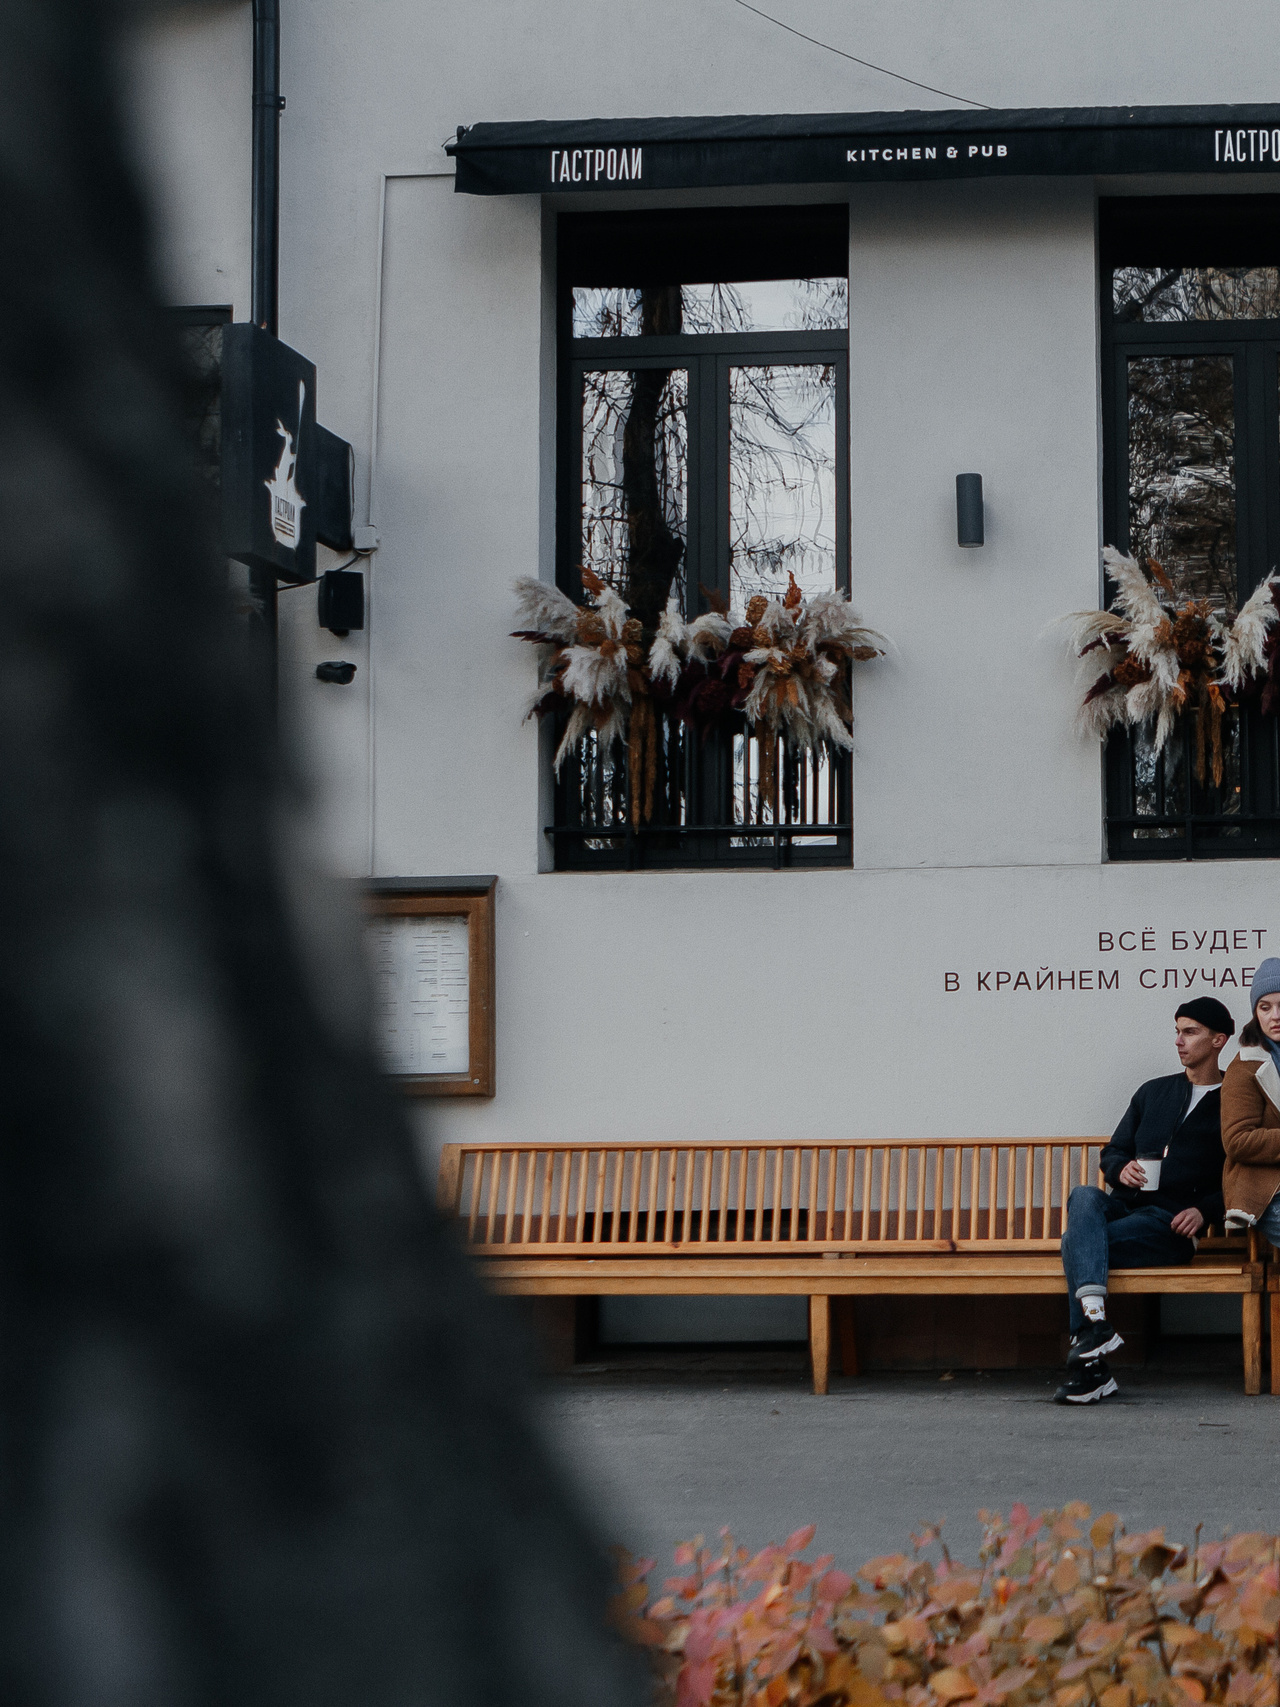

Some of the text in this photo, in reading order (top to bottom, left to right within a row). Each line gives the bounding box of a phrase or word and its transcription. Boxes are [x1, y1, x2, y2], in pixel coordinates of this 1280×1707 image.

[550, 147, 643, 183] ГАСТРОЛИ
[846, 145, 1009, 162] KITCHEN & PUB
[1098, 926, 1157, 952] ВСЁ
[1172, 929, 1268, 954] БУДЕТ
[944, 972, 960, 992] В
[976, 966, 1120, 992] КРАЙНЕМ
[1139, 967, 1255, 989] СЛУЧАЕ
